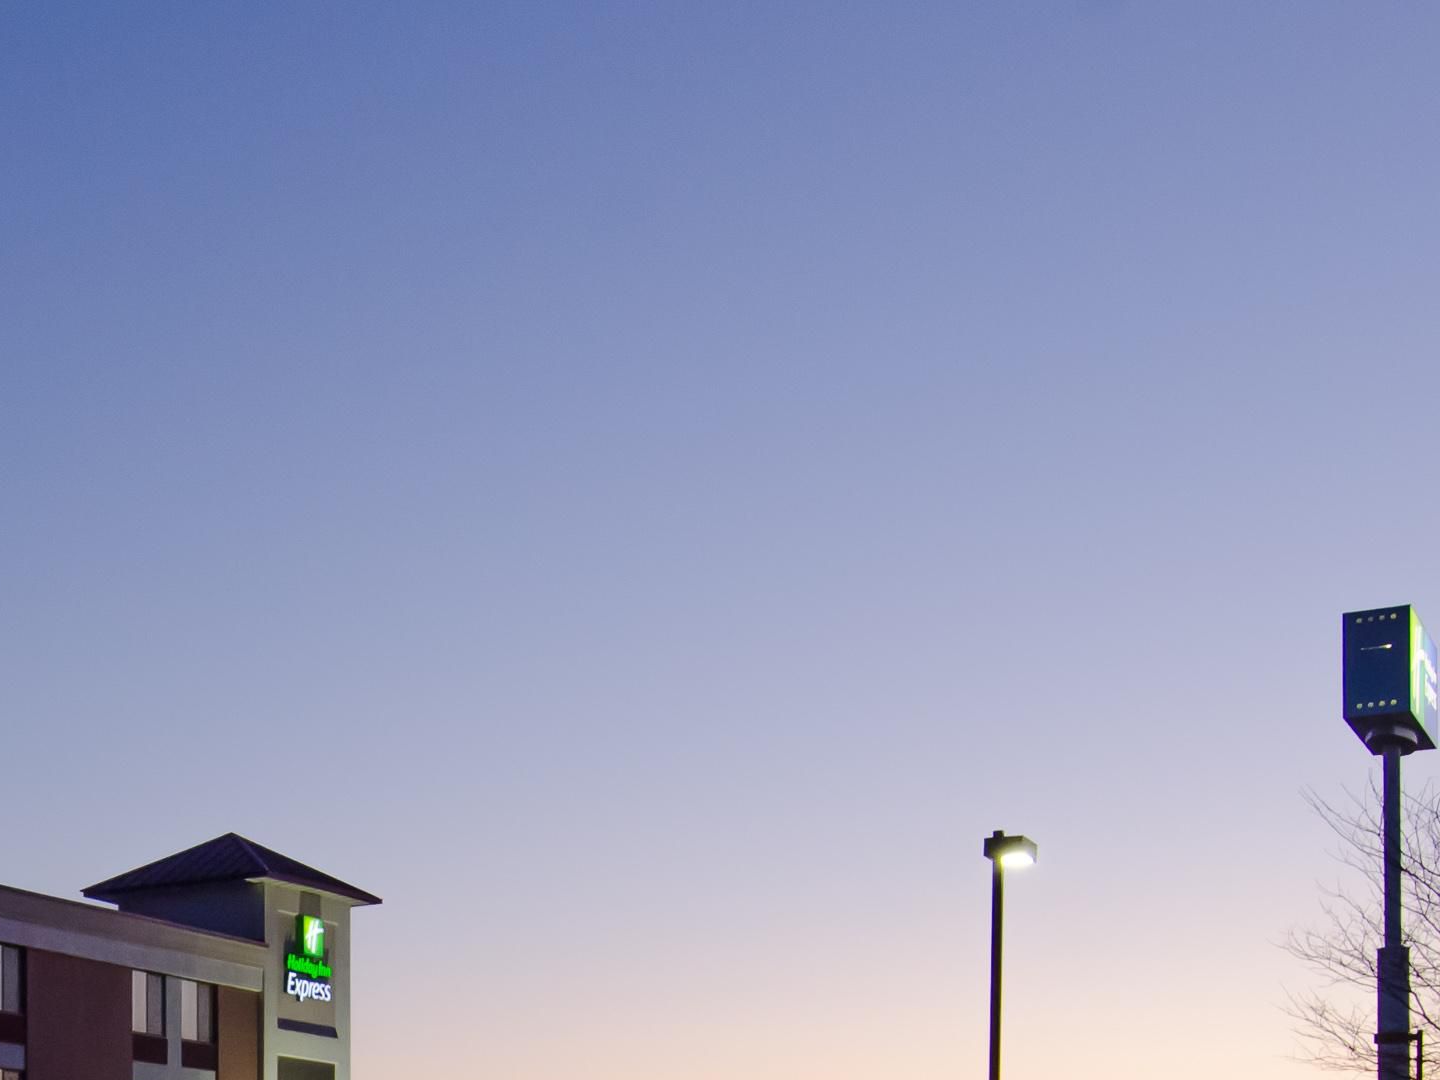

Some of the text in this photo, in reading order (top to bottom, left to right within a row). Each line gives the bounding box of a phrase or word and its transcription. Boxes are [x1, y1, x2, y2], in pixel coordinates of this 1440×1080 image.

[287, 953, 331, 979] Holiday Inn
[287, 971, 331, 1002] Express
